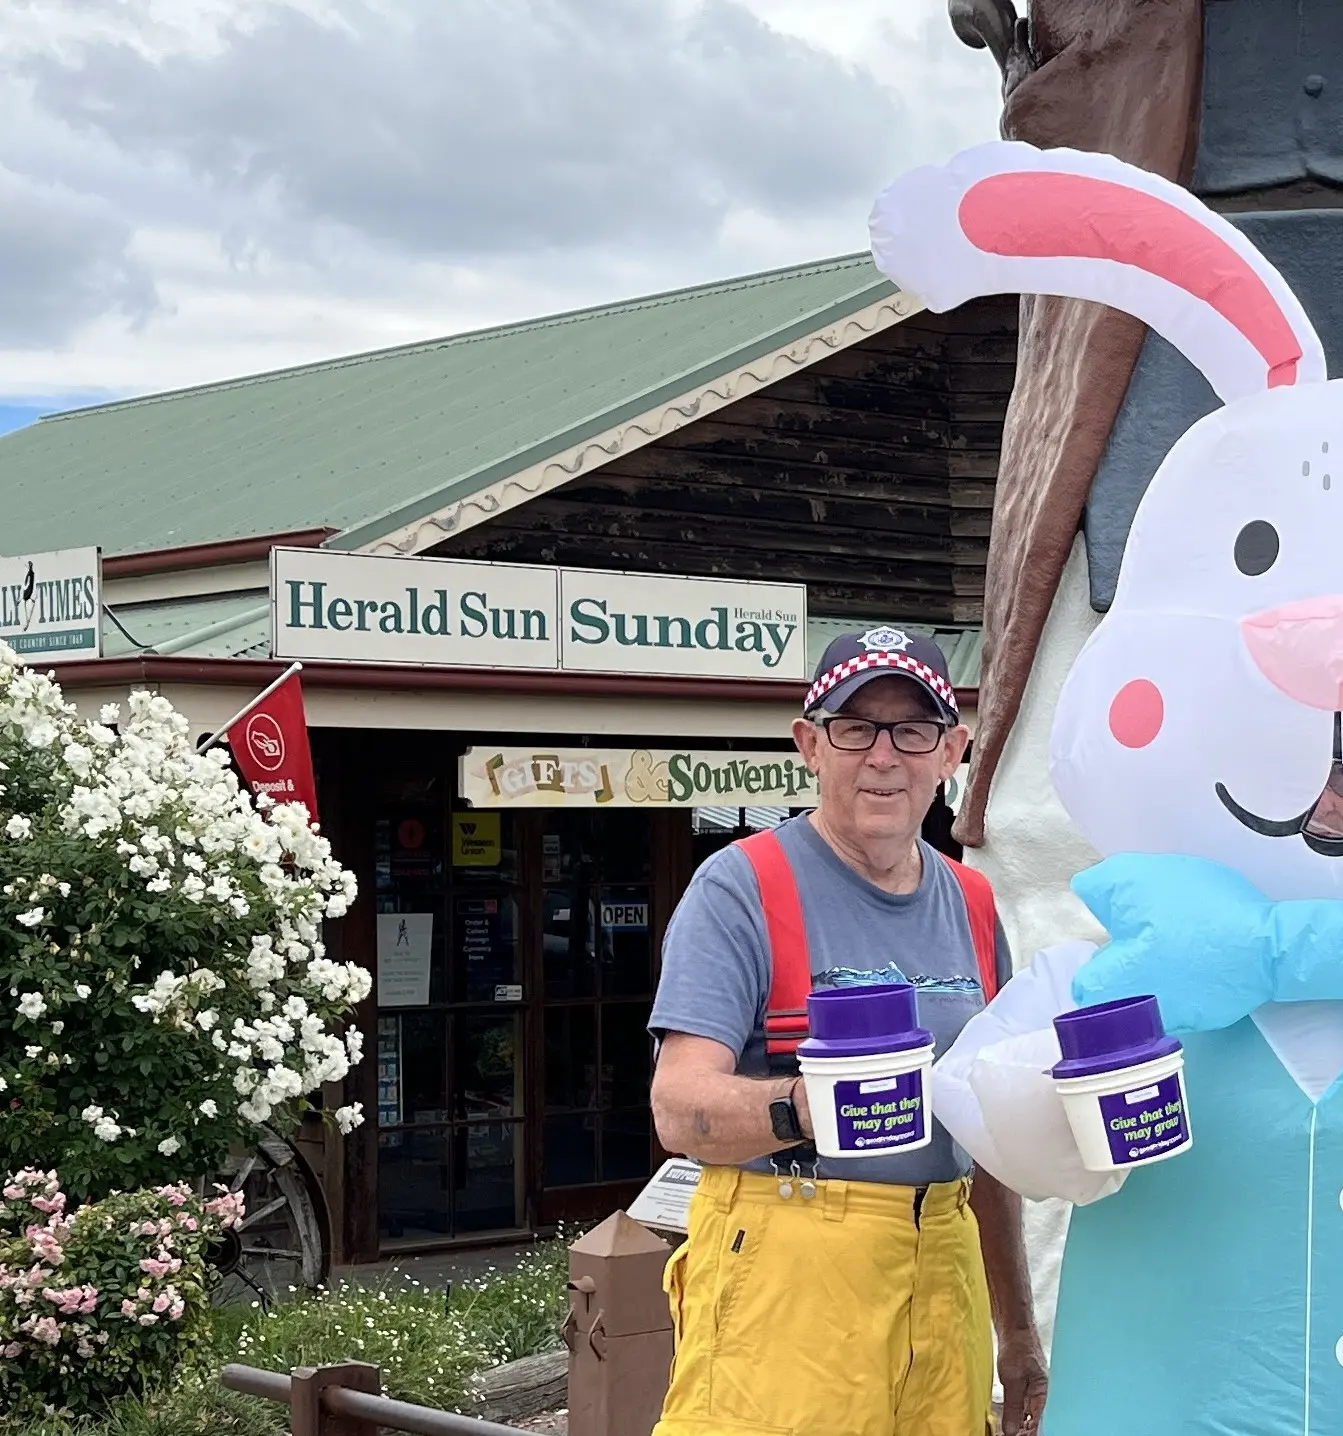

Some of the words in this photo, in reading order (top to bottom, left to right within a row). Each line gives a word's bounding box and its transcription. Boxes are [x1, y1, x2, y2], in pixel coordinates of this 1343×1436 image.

[0, 584, 23, 627] LY
[36, 575, 94, 623] TIMES
[285, 580, 452, 636] Herald
[460, 592, 549, 640] Sun
[734, 607, 773, 621] Herald
[775, 609, 798, 622] Sun
[570, 598, 797, 667] Sunday
[251, 779, 287, 793] Deposit
[287, 778, 295, 792] &
[501, 758, 600, 791] GIFTS
[625, 749, 672, 802] &
[669, 753, 820, 802] Souvenir
[461, 839, 495, 848] Western
[603, 906, 644, 925] OPEN
[841, 1104, 867, 1117] Give
[871, 1102, 896, 1115] that
[899, 1096, 921, 1111] they
[853, 1119, 881, 1132] may
[884, 1113, 914, 1131] grow
[1110, 1117, 1137, 1131] Give
[1139, 1108, 1163, 1124] that
[1124, 1126, 1151, 1142] may
[1155, 1116, 1179, 1137] grow
